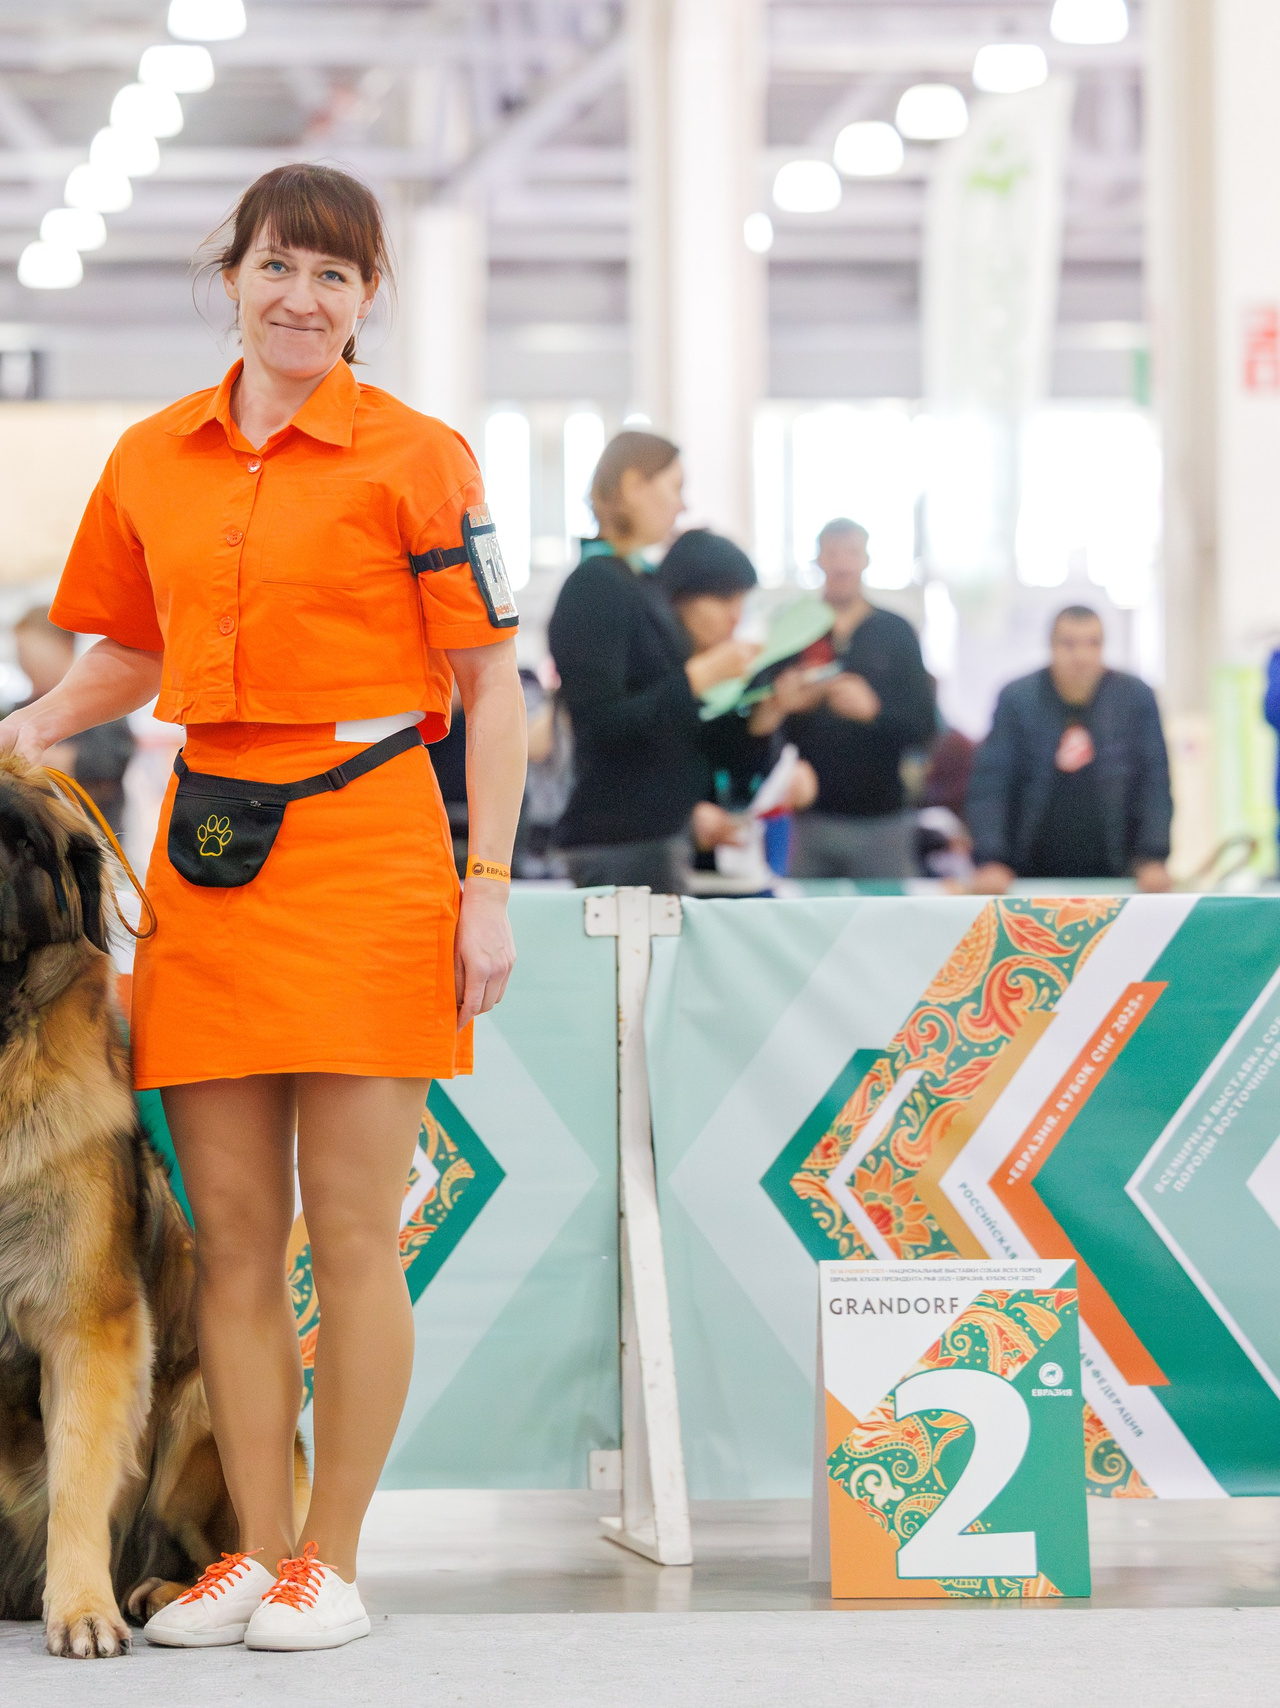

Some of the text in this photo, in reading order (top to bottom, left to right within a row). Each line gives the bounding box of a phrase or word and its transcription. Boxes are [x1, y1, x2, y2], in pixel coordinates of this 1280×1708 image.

[1056, 1062, 1096, 1113] КУБОК
[1090, 1034, 1116, 1063] СНГ
[1153, 1115, 1214, 1193] ВСЕМИРНАЯ
[1209, 1046, 1265, 1117] ВЫСТАВКА
[1173, 1134, 1217, 1192] ПОРОДЫ
[829, 1297, 959, 1315] GRANDORF
[1031, 1388, 1073, 1397] ЕВРАЗИЯ
[895, 1368, 1038, 1578] 2
